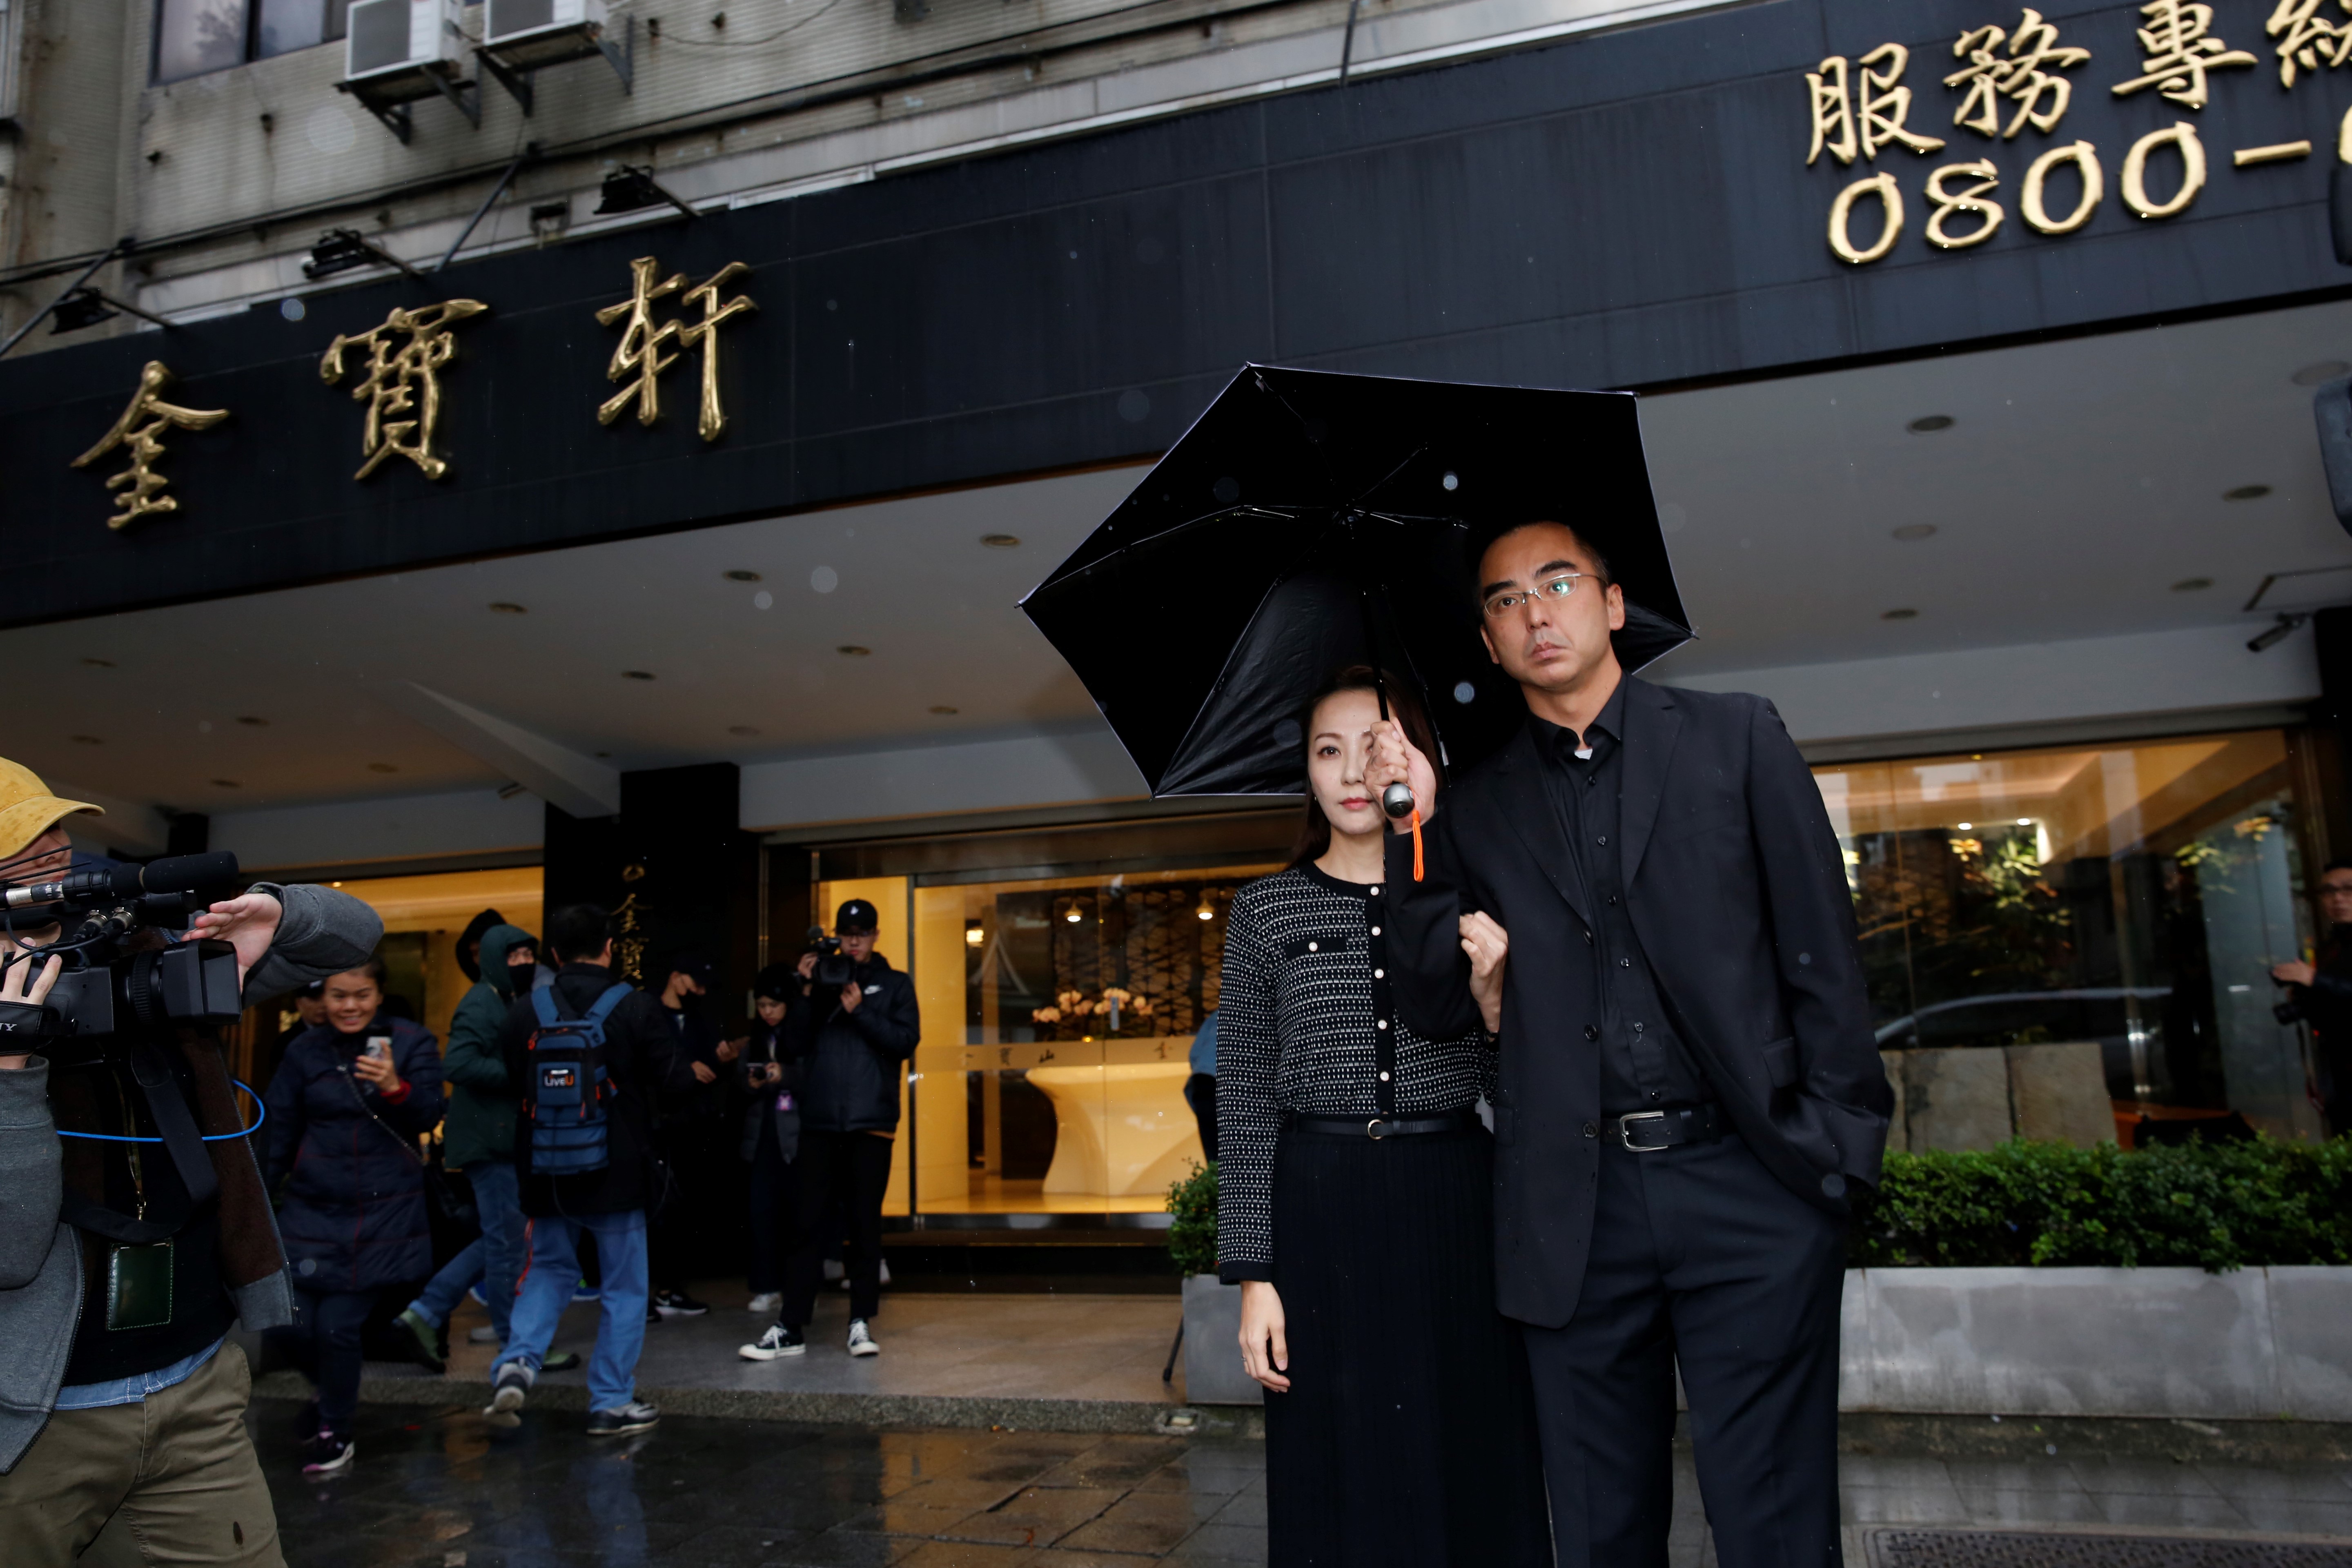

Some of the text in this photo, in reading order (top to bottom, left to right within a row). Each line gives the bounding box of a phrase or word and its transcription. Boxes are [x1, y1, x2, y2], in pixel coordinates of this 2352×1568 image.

[1829, 106, 2352, 263] 0800-
[70, 256, 759, 530] 金寶軒
